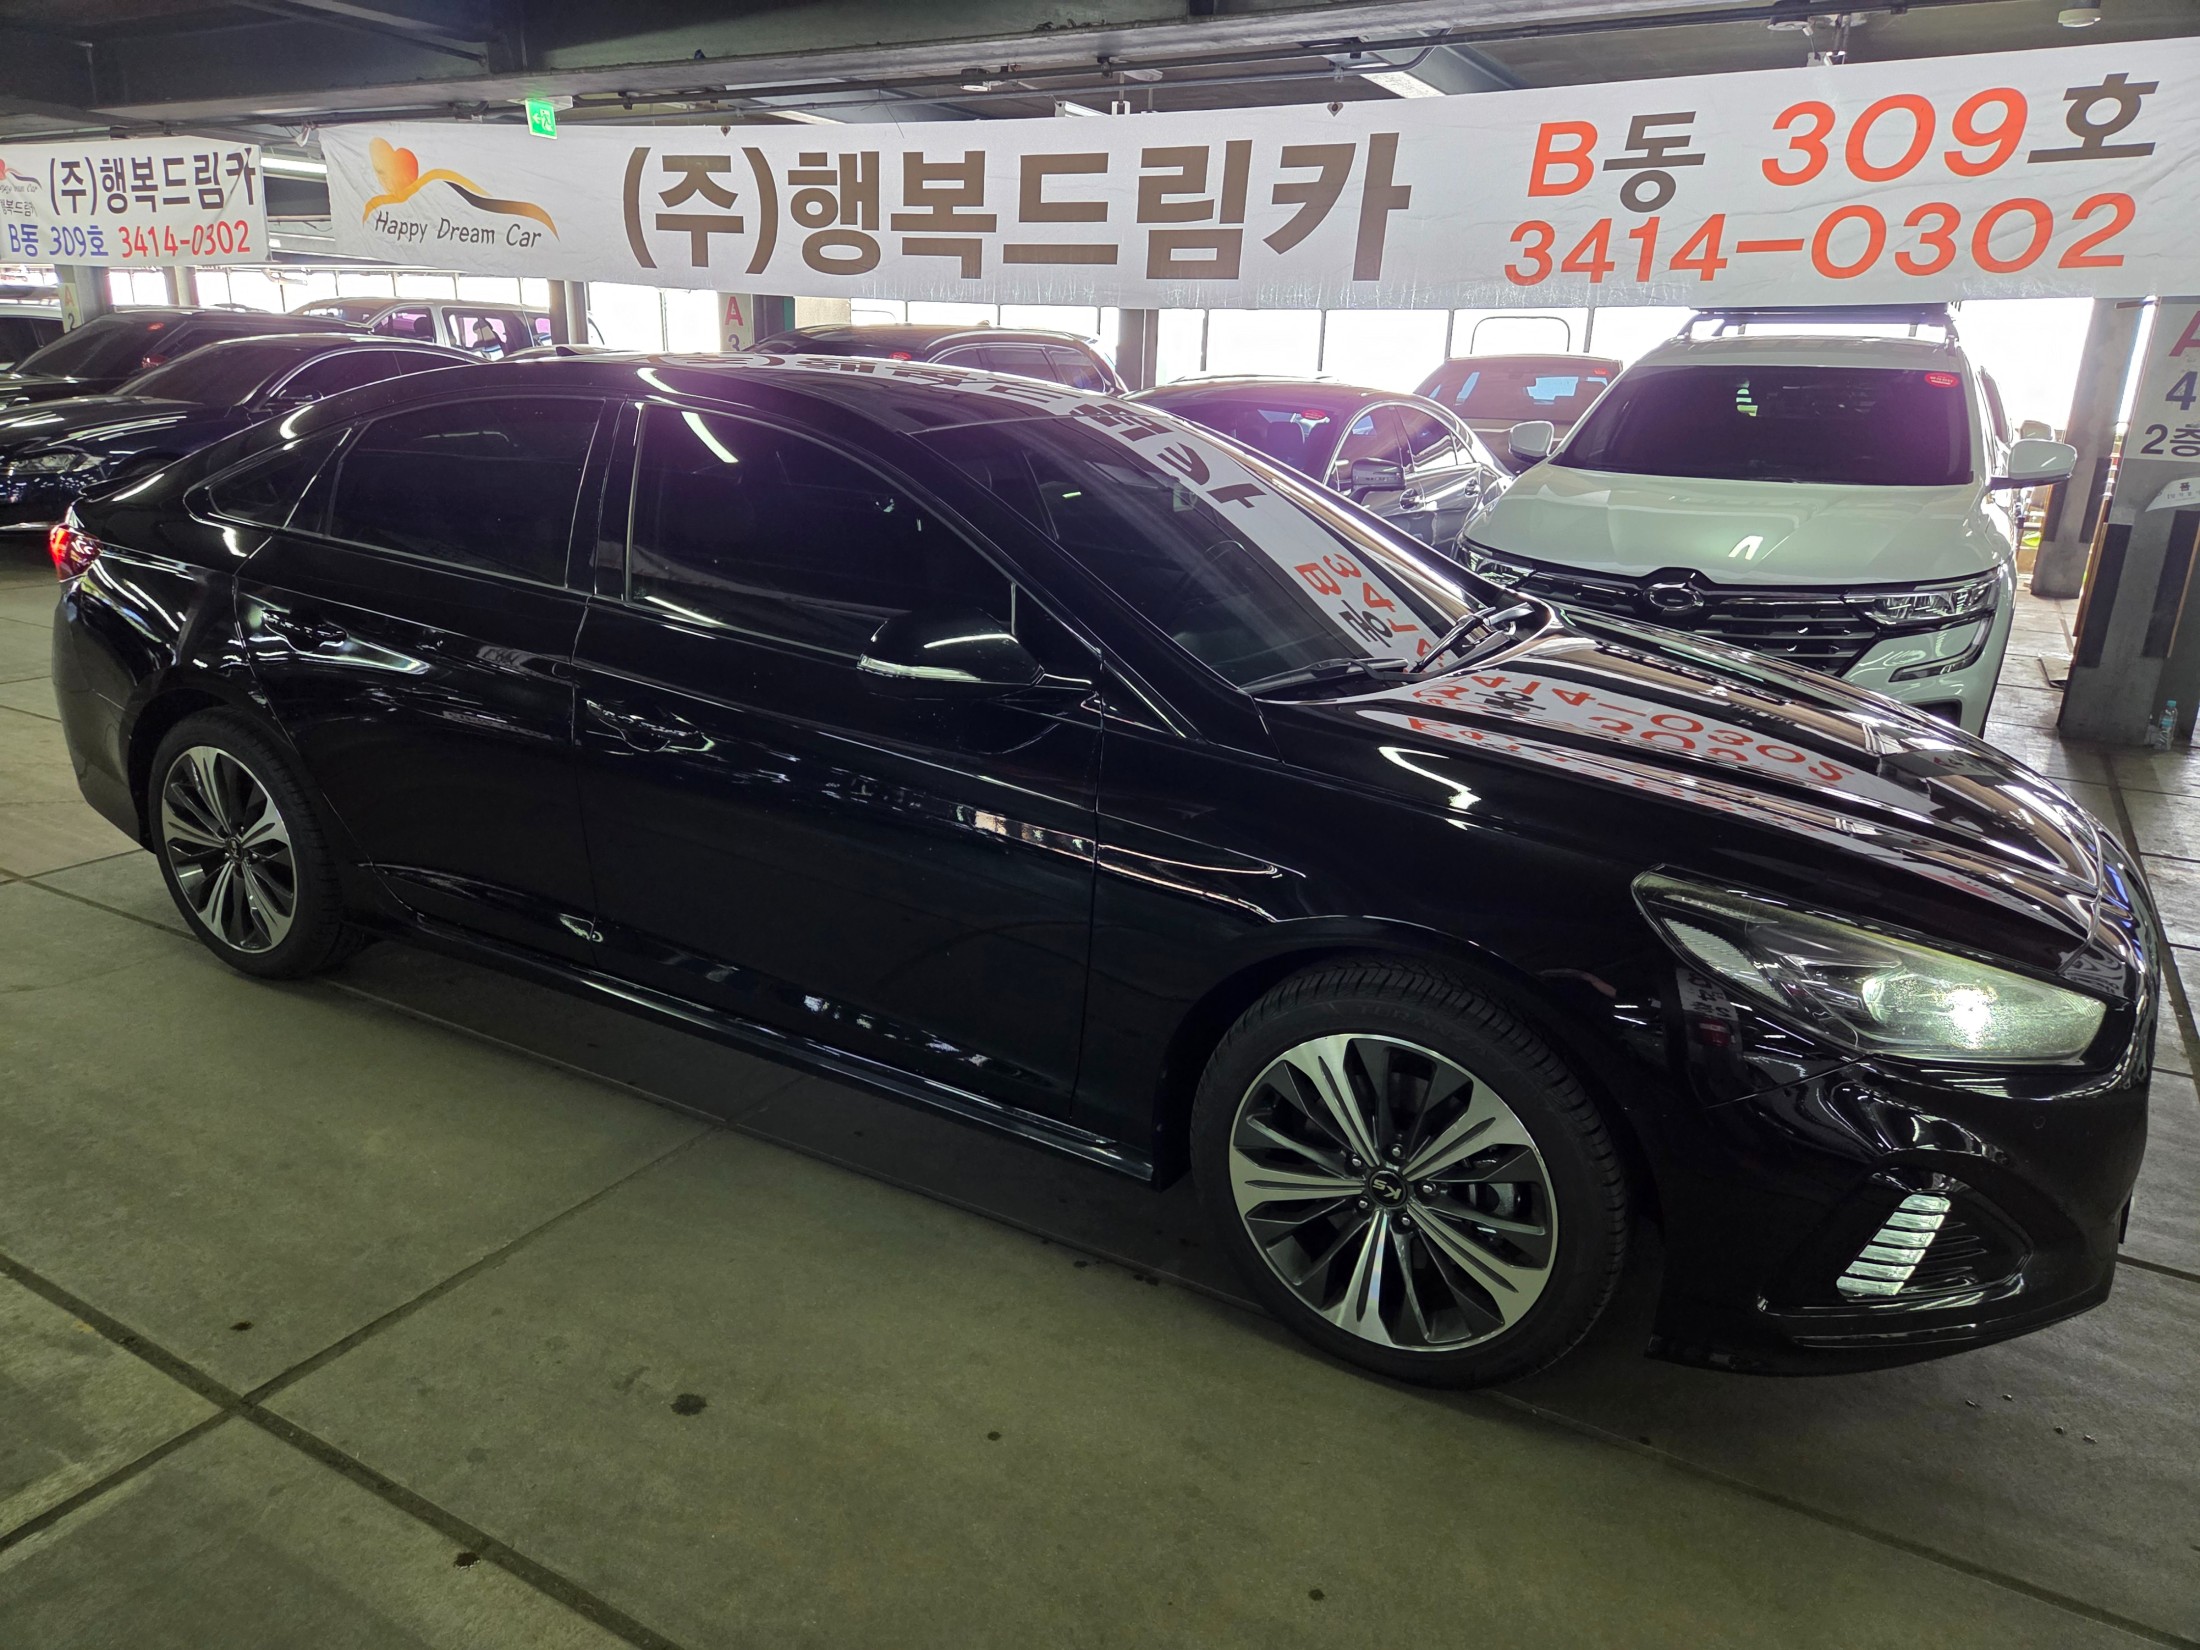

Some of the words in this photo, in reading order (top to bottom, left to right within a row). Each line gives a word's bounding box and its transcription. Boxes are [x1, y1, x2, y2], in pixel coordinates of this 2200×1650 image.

[1527, 111, 1706, 213] B동
[1761, 72, 2160, 187] 309호
[50, 147, 256, 216] (주)행복드림카
[622, 131, 1412, 282] (주)행복드림카
[8, 223, 39, 257] B동
[49, 224, 109, 258] 309호
[118, 219, 250, 258] 3414-0302
[375, 210, 428, 244] Happy
[437, 217, 495, 245] Dream
[506, 223, 542, 248] Car
[1504, 192, 2136, 286] 3414-0302
[724, 296, 744, 327] A
[2165, 371, 2198, 411] 4
